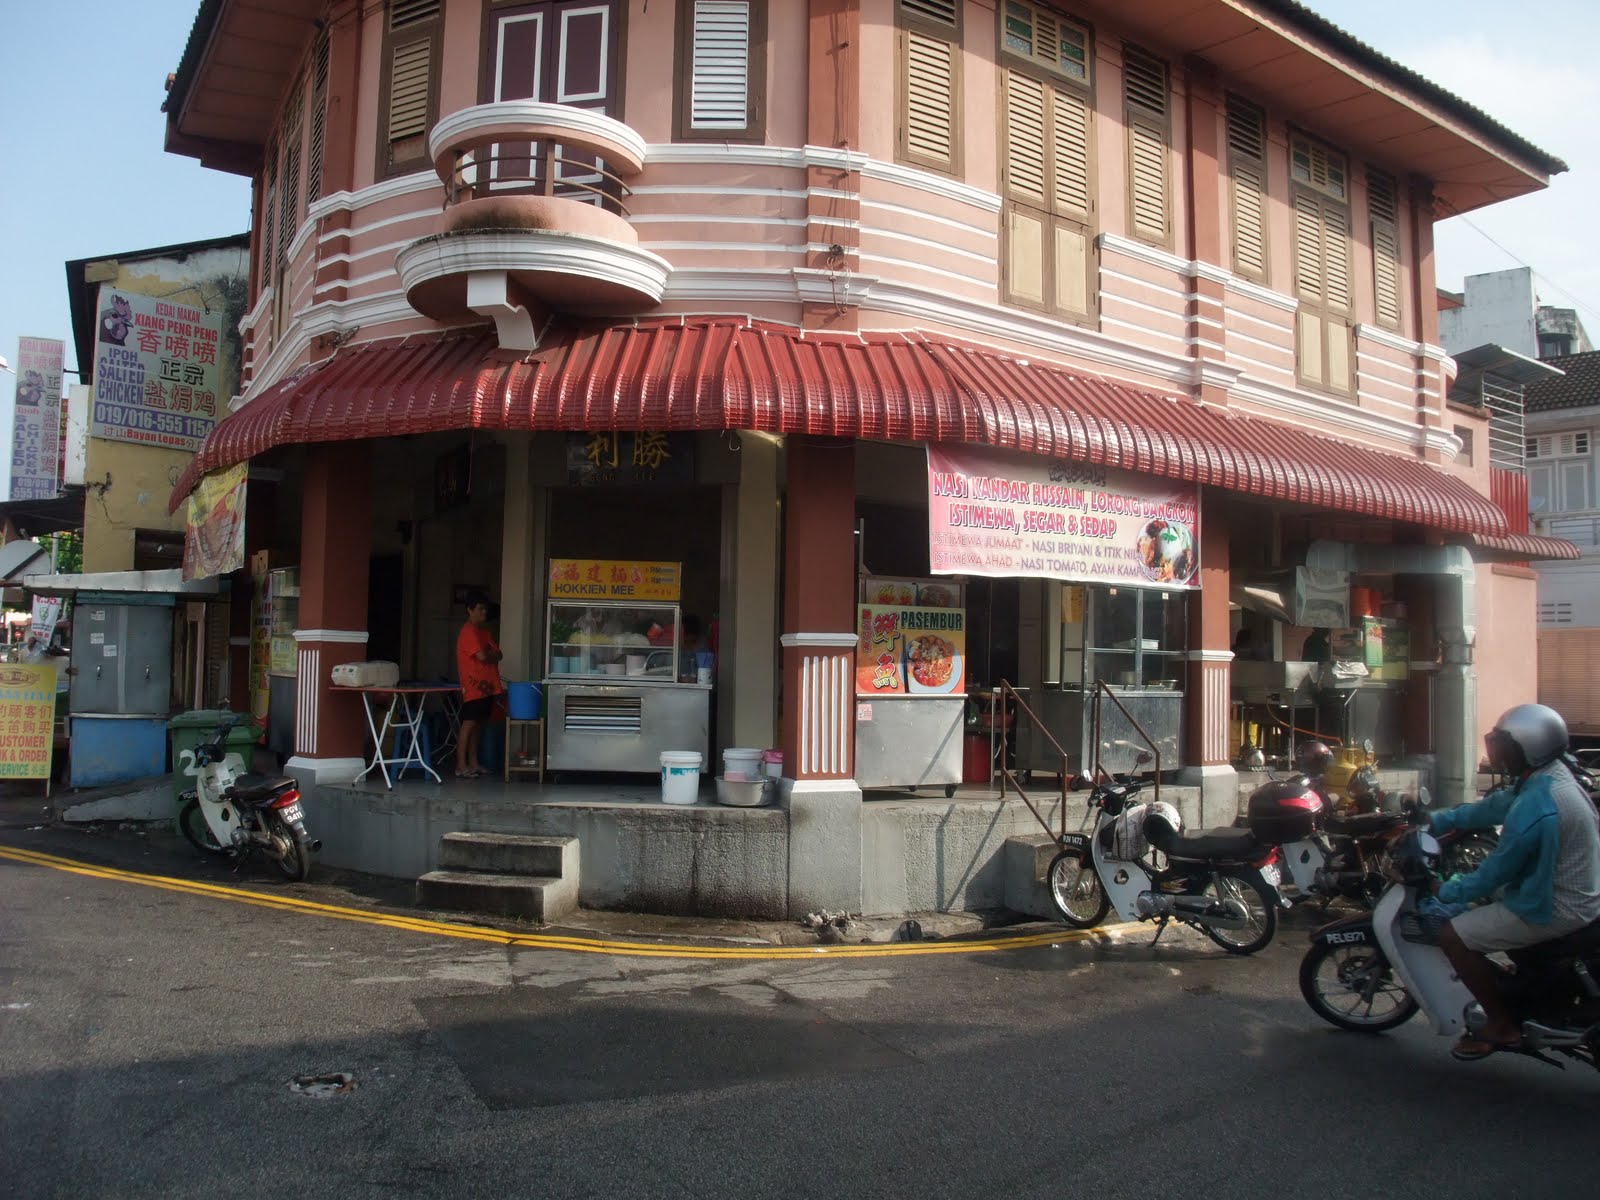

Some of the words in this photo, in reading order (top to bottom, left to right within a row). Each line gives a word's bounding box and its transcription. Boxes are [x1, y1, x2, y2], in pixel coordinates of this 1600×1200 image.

[155, 302, 175, 318] KEDAI
[177, 307, 201, 324] MAKAN
[134, 313, 165, 331] XIANG
[167, 320, 192, 338] PENG
[193, 326, 218, 343] PENG
[108, 347, 138, 362] IPOH
[136, 328, 217, 366] 香喷喷
[159, 356, 205, 386] 正宗
[98, 378, 144, 406] CHICKEN
[96, 403, 183, 434] 019/016-555
[185, 418, 213, 438] 1154
[933, 472, 968, 498] NASI
[971, 476, 1031, 504] KANDAR
[1091, 490, 1140, 518] LORONG
[1142, 501, 1195, 524] BANGKOK
[949, 503, 1021, 535] ISTIMEWA,
[1023, 510, 1066, 534] SEGAR
[1068, 514, 1078, 535] &
[1080, 515, 1117, 540] SEDAP
[934, 531, 981, 547] ISTIMEWA
[985, 536, 1023, 550] JUMAAT
[1032, 540, 1056, 553] NASI
[1058, 542, 1093, 556] BRIYANI
[1095, 546, 1102, 557] &
[933, 552, 982, 566] ISTIMEWA
[985, 556, 1013, 567] AHAD
[1021, 558, 1044, 571] NASI
[1091, 563, 1115, 574] AYAM
[555, 583, 607, 595] HOKKIEN
[611, 585, 635, 595] MEE
[901, 611, 963, 631] PASEMBUR
[10, 749, 16, 762] &
[18, 750, 48, 762] ORDER
[0, 762, 29, 776] ERVICE
